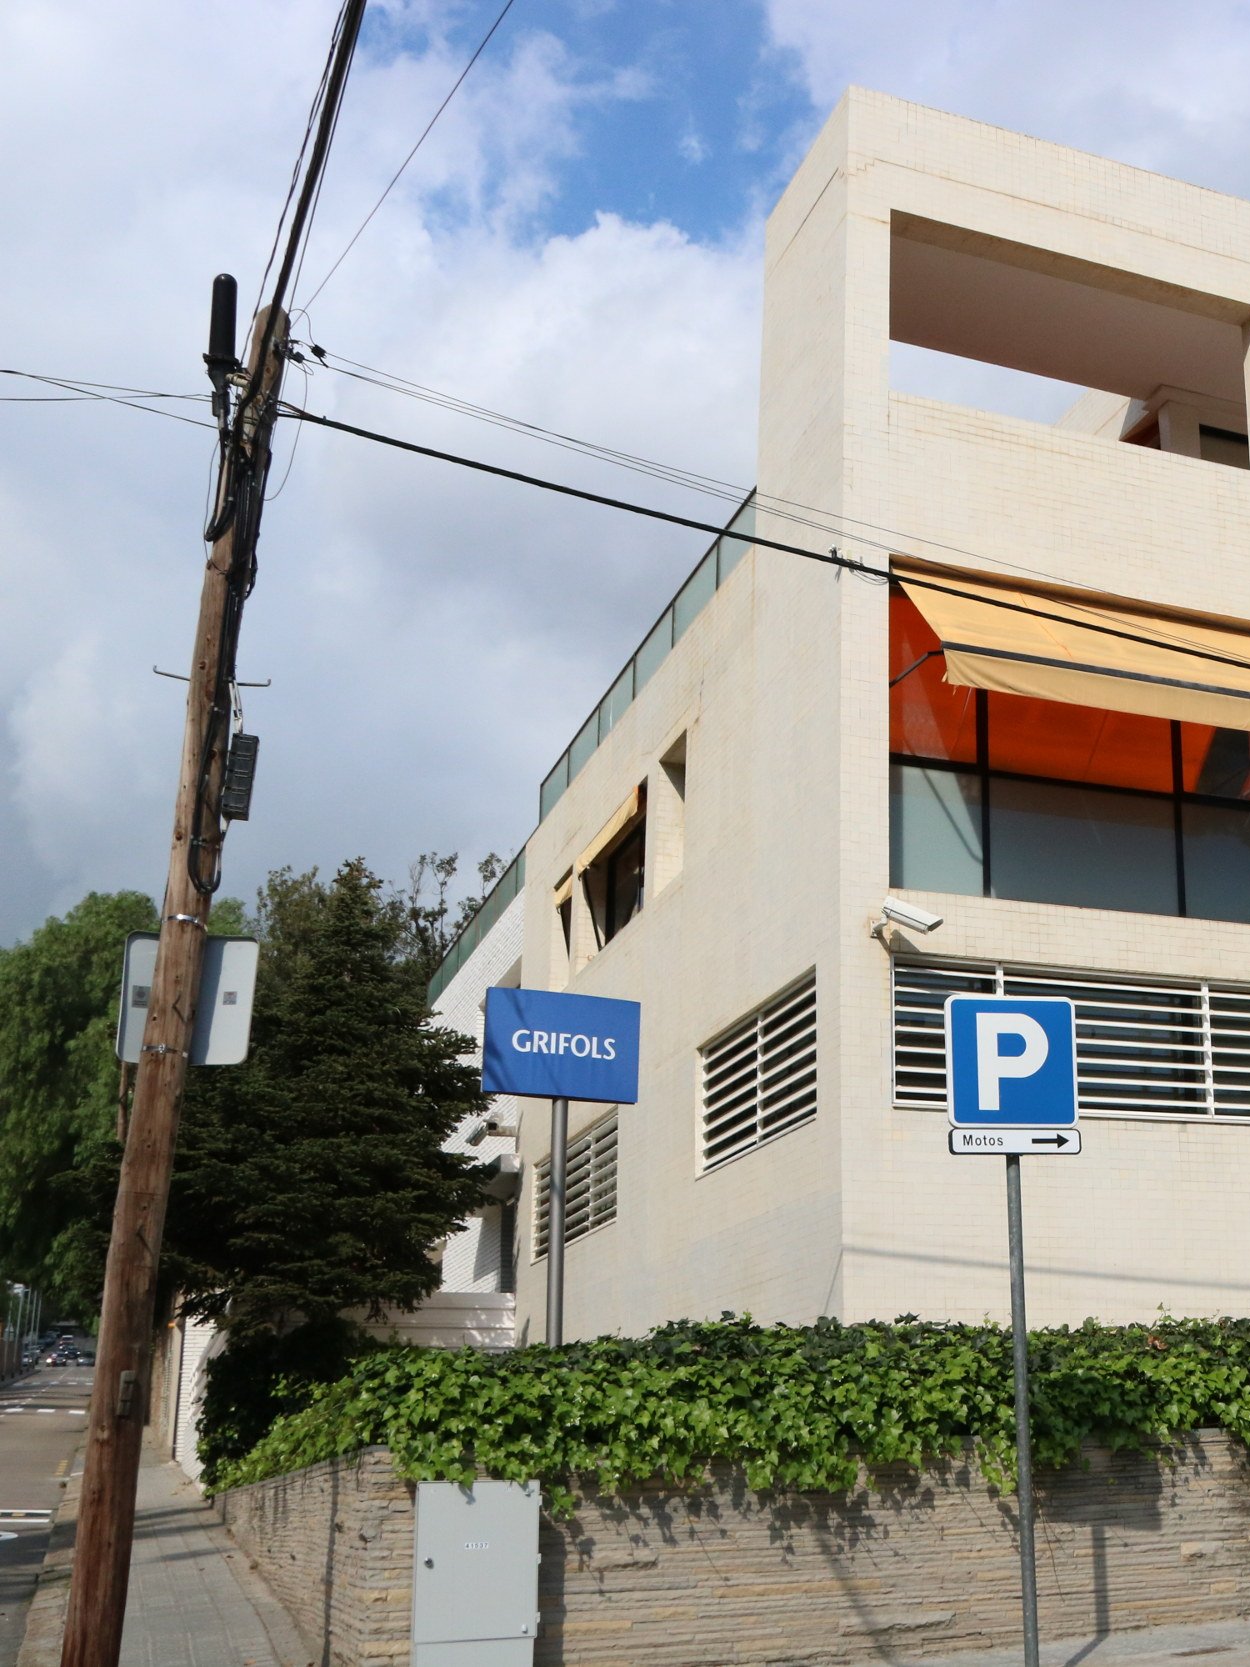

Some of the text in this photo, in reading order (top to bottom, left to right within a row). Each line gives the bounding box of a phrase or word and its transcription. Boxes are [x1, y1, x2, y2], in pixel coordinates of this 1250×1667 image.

[512, 1029, 616, 1061] GRIFOLS
[976, 1013, 1049, 1111] P
[963, 1134, 1004, 1147] Motos
